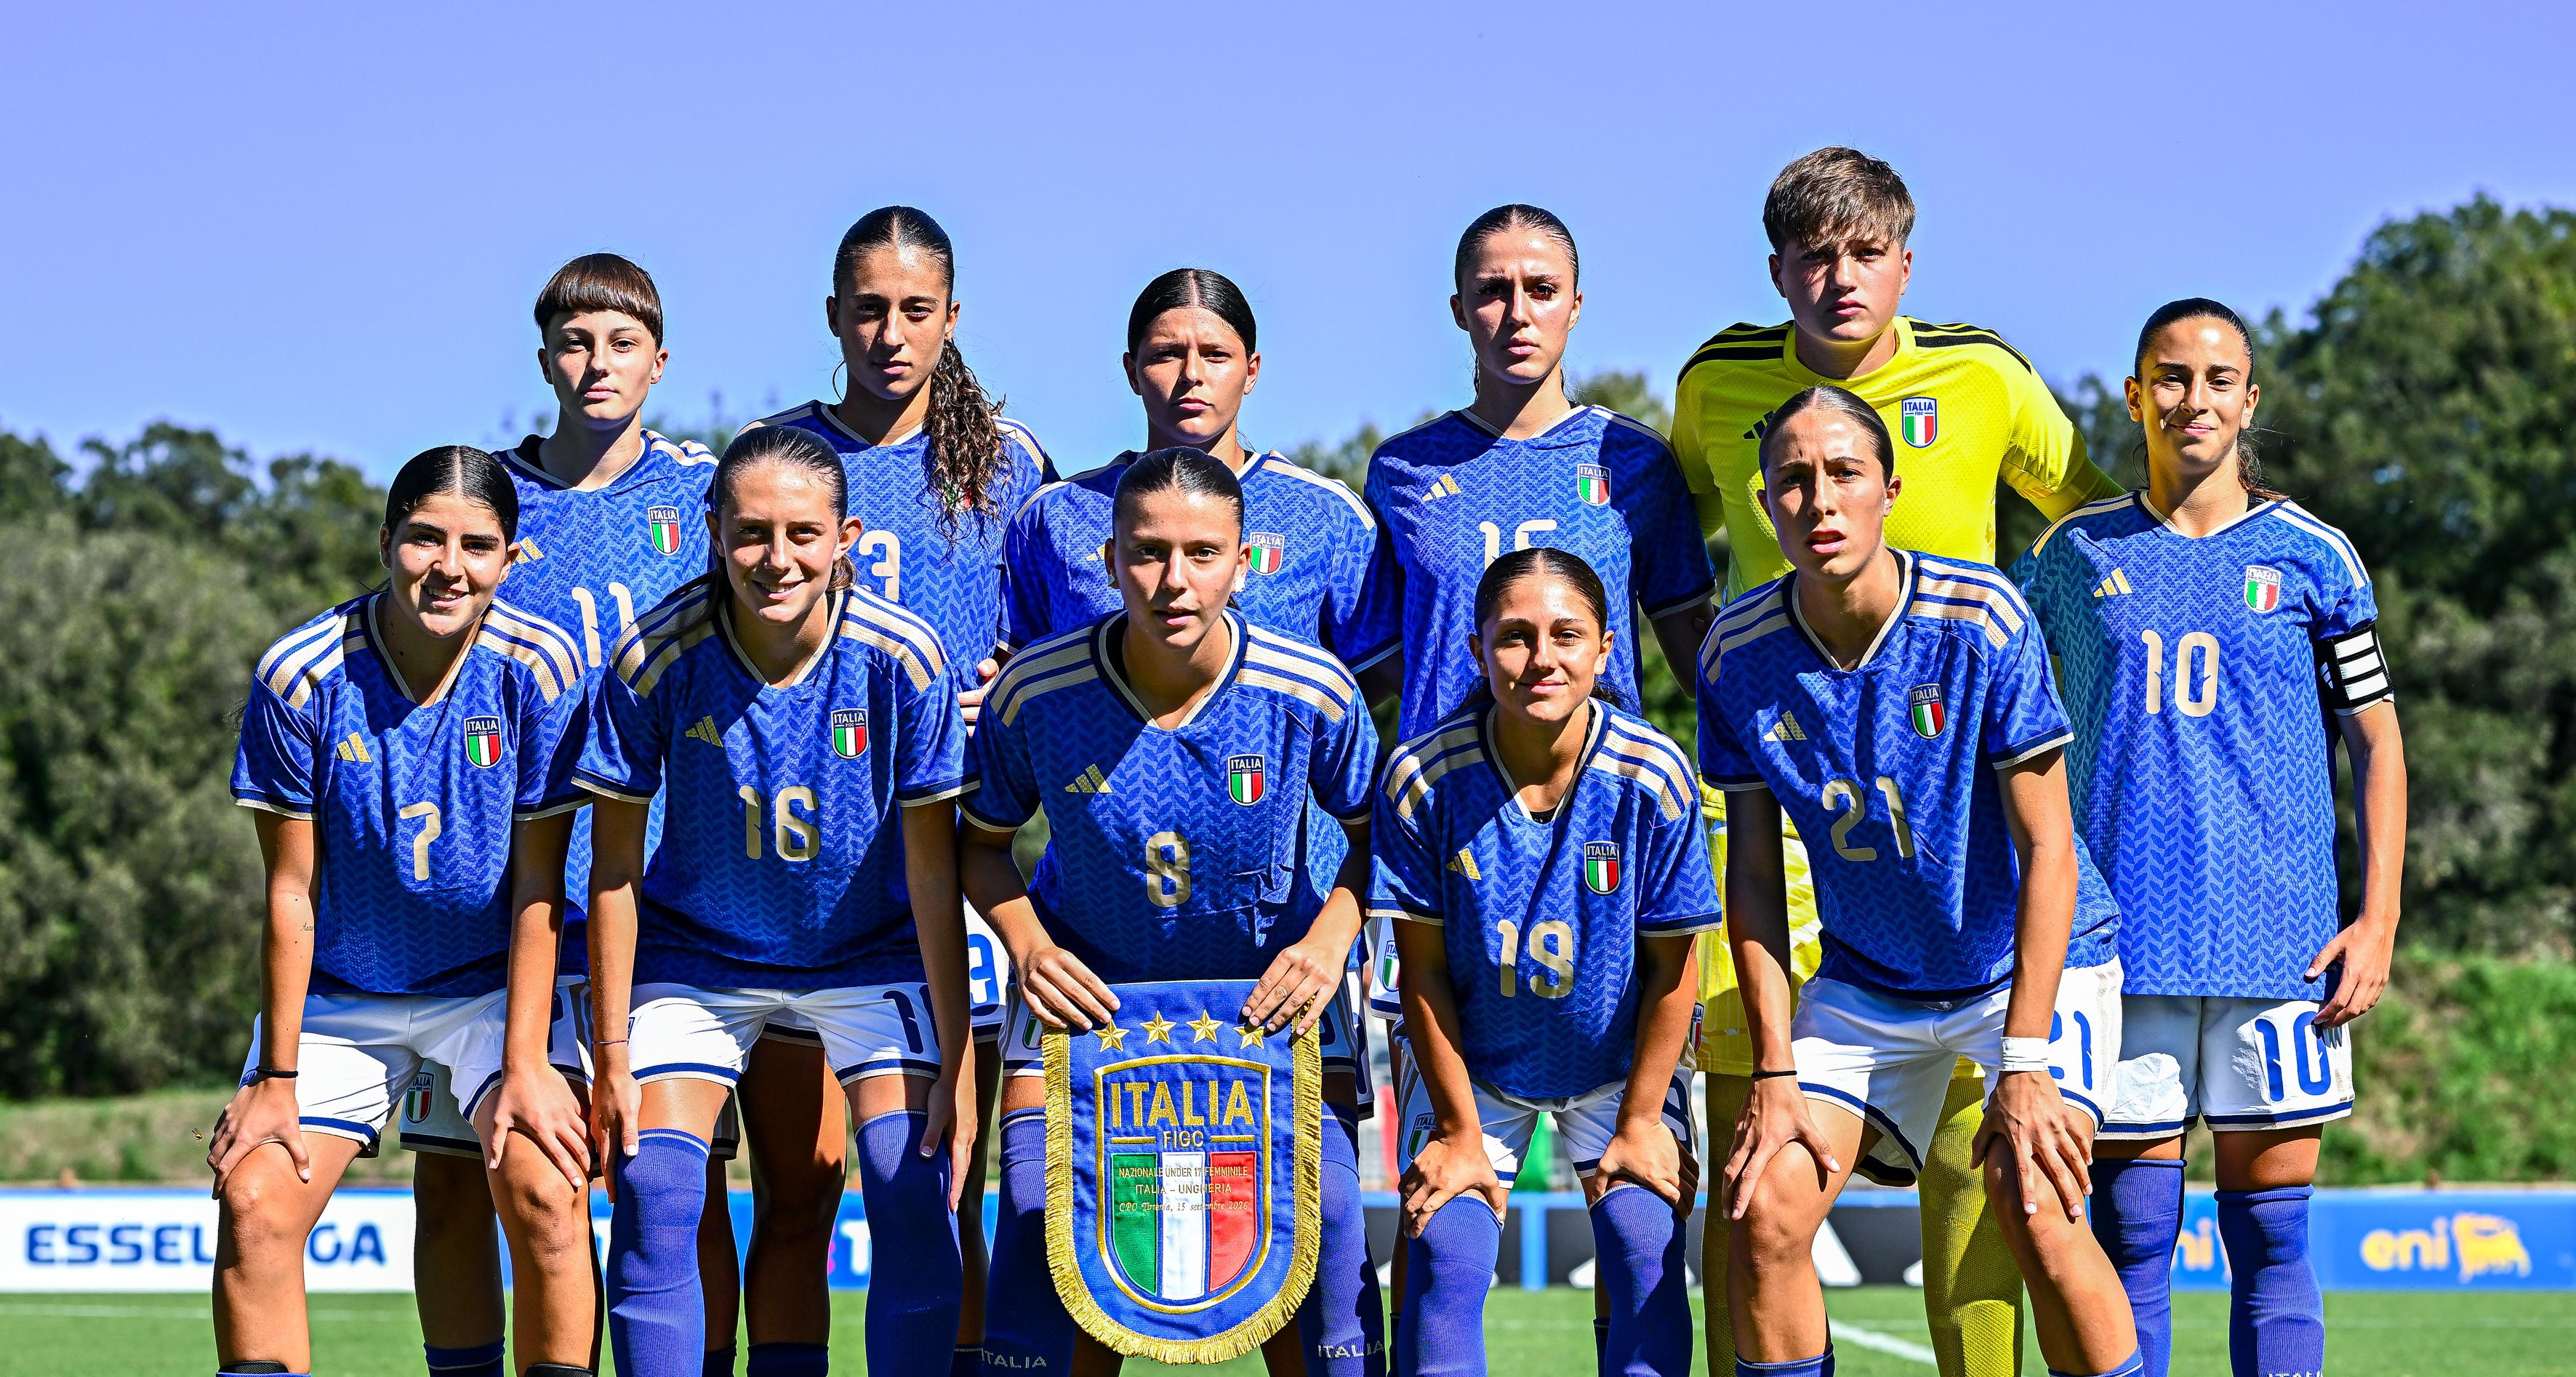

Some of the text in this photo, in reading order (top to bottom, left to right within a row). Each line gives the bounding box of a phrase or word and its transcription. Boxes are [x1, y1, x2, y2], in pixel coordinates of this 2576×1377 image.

[1904, 401, 1934, 412] ITALIA
[1580, 466, 1608, 478] ITALIA
[650, 510, 677, 521] ITALIA
[1252, 534, 1282, 547] ITALIA
[571, 582, 634, 667] 11
[2140, 630, 2220, 718] 10
[1911, 688, 1939, 702] ITALIA
[467, 720, 498, 731] ITALIA
[834, 712, 866, 725] ITALIA
[1230, 758, 1261, 769] ITALIA
[739, 784, 820, 861] 16
[1821, 776, 1914, 862] 21
[399, 800, 441, 880] 7
[1586, 845, 1616, 856] ITALIA
[1145, 831, 1191, 907] 8
[1497, 918, 1574, 998] 19
[2047, 1010, 2093, 1091] 1
[2255, 1011, 2330, 1101] 10
[412, 1077, 431, 1087] ALIA
[1110, 1080, 1255, 1128] ITALIA
[1416, 1117, 1437, 1126] ITALI
[1662, 1075, 1693, 1154] 9
[1163, 1130, 1205, 1149] FIGC
[1119, 1166, 1248, 1178] NAZIONALE UNDER 17 FEMMINILE
[1136, 1184, 1167, 1195] ITALIA
[1179, 1183, 1232, 1194] UNGHERIA
[1119, 1202, 1138, 1212] CPO
[1177, 1203, 1186, 1211] 15
[1189, 1200, 1224, 1211] settembre
[28, 1224, 386, 1264] ESSELGA
[2172, 1217, 2213, 1270] ni
[2360, 1216, 2449, 1271] eni
[981, 1348, 1047, 1368] ITALIA
[1318, 1340, 1384, 1358] ITALIA
